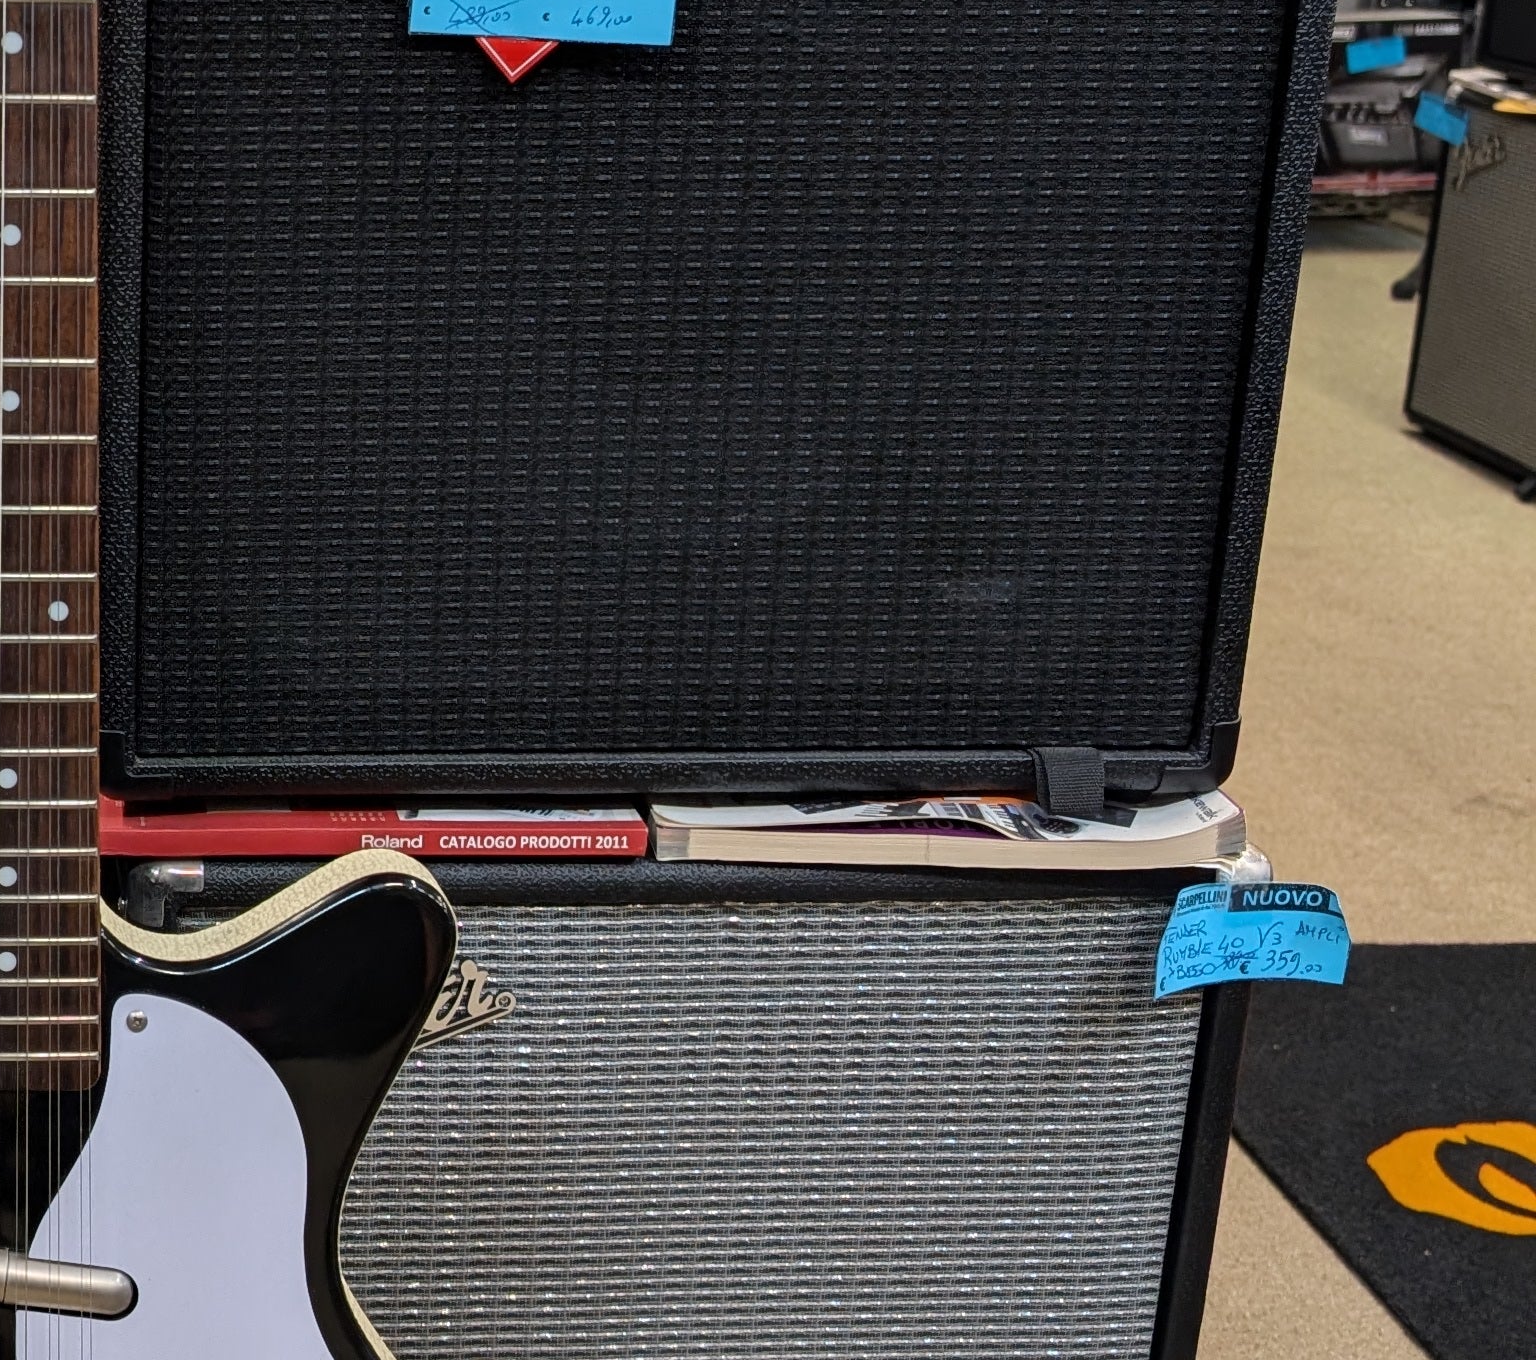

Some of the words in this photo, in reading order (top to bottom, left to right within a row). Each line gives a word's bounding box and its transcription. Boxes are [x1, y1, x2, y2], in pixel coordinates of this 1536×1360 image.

[361, 834, 424, 850] Roland
[439, 835, 517, 850] CATALOGO
[519, 835, 592, 850] PRODOTTI
[595, 835, 629, 850] 2011
[1177, 889, 1228, 910] SCARPELLINI
[1242, 889, 1323, 907] NUOVO
[1217, 935, 1245, 954] 40
